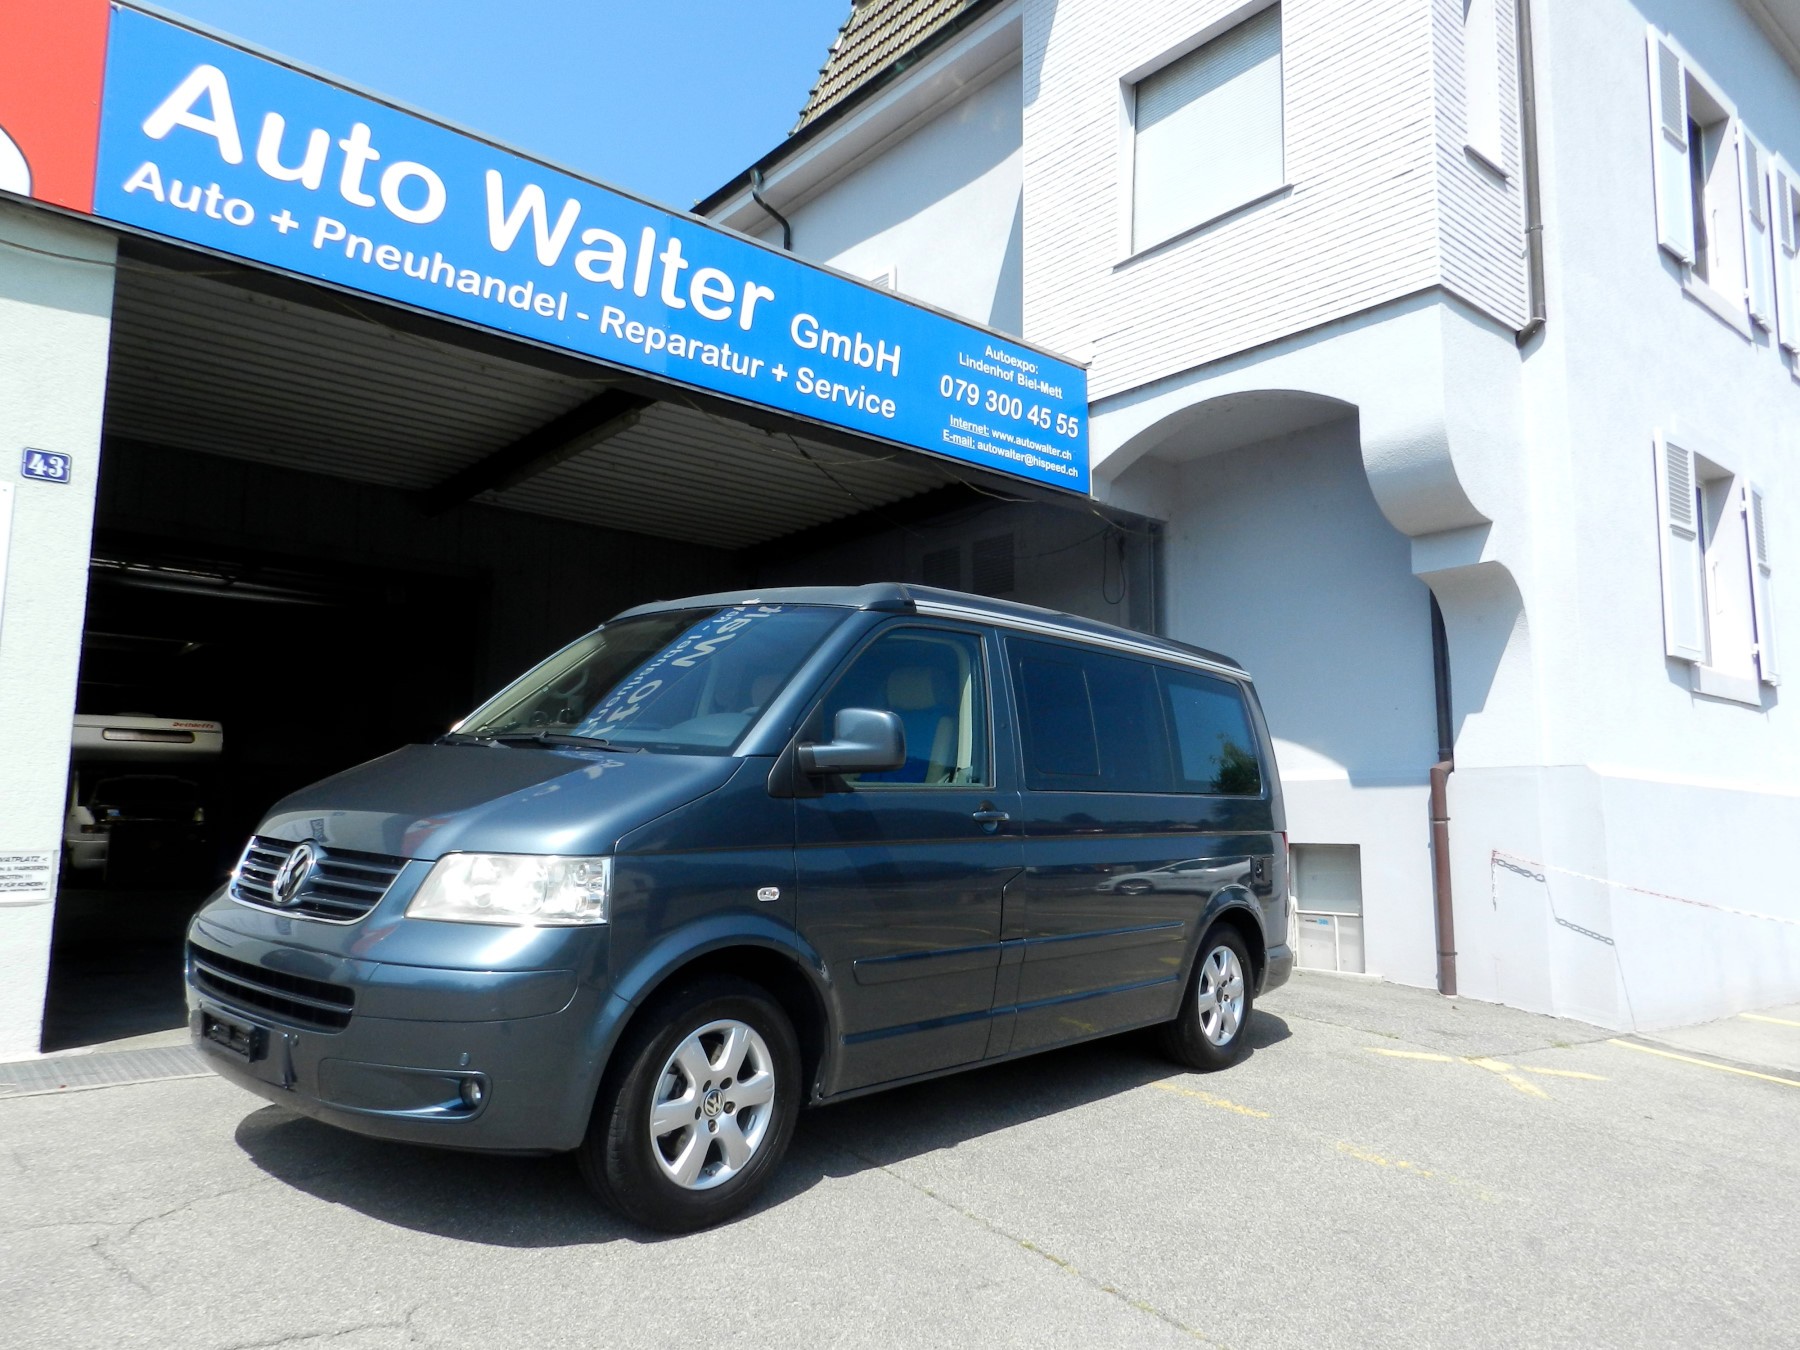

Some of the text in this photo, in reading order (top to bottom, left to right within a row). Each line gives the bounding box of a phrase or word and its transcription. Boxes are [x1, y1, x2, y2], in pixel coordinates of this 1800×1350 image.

[142, 64, 901, 377] Auto Walter GmbH
[123, 162, 255, 227] Auto
[270, 209, 299, 235] +
[313, 216, 568, 321] Pneuhandel
[600, 305, 764, 379] Reparatur
[771, 362, 788, 382] +
[796, 367, 897, 419] Service
[959, 352, 1063, 400] Lindenhof Biel-Mett
[985, 344, 1039, 374] Autoexpo:
[940, 374, 1079, 438] 079 300 45 55
[943, 429, 1079, 478] E-mail: autowalter@hispeed.ch
[950, 414, 1072, 461] Internet: www.autowalter.ch
[28, 453, 64, 478] 43
